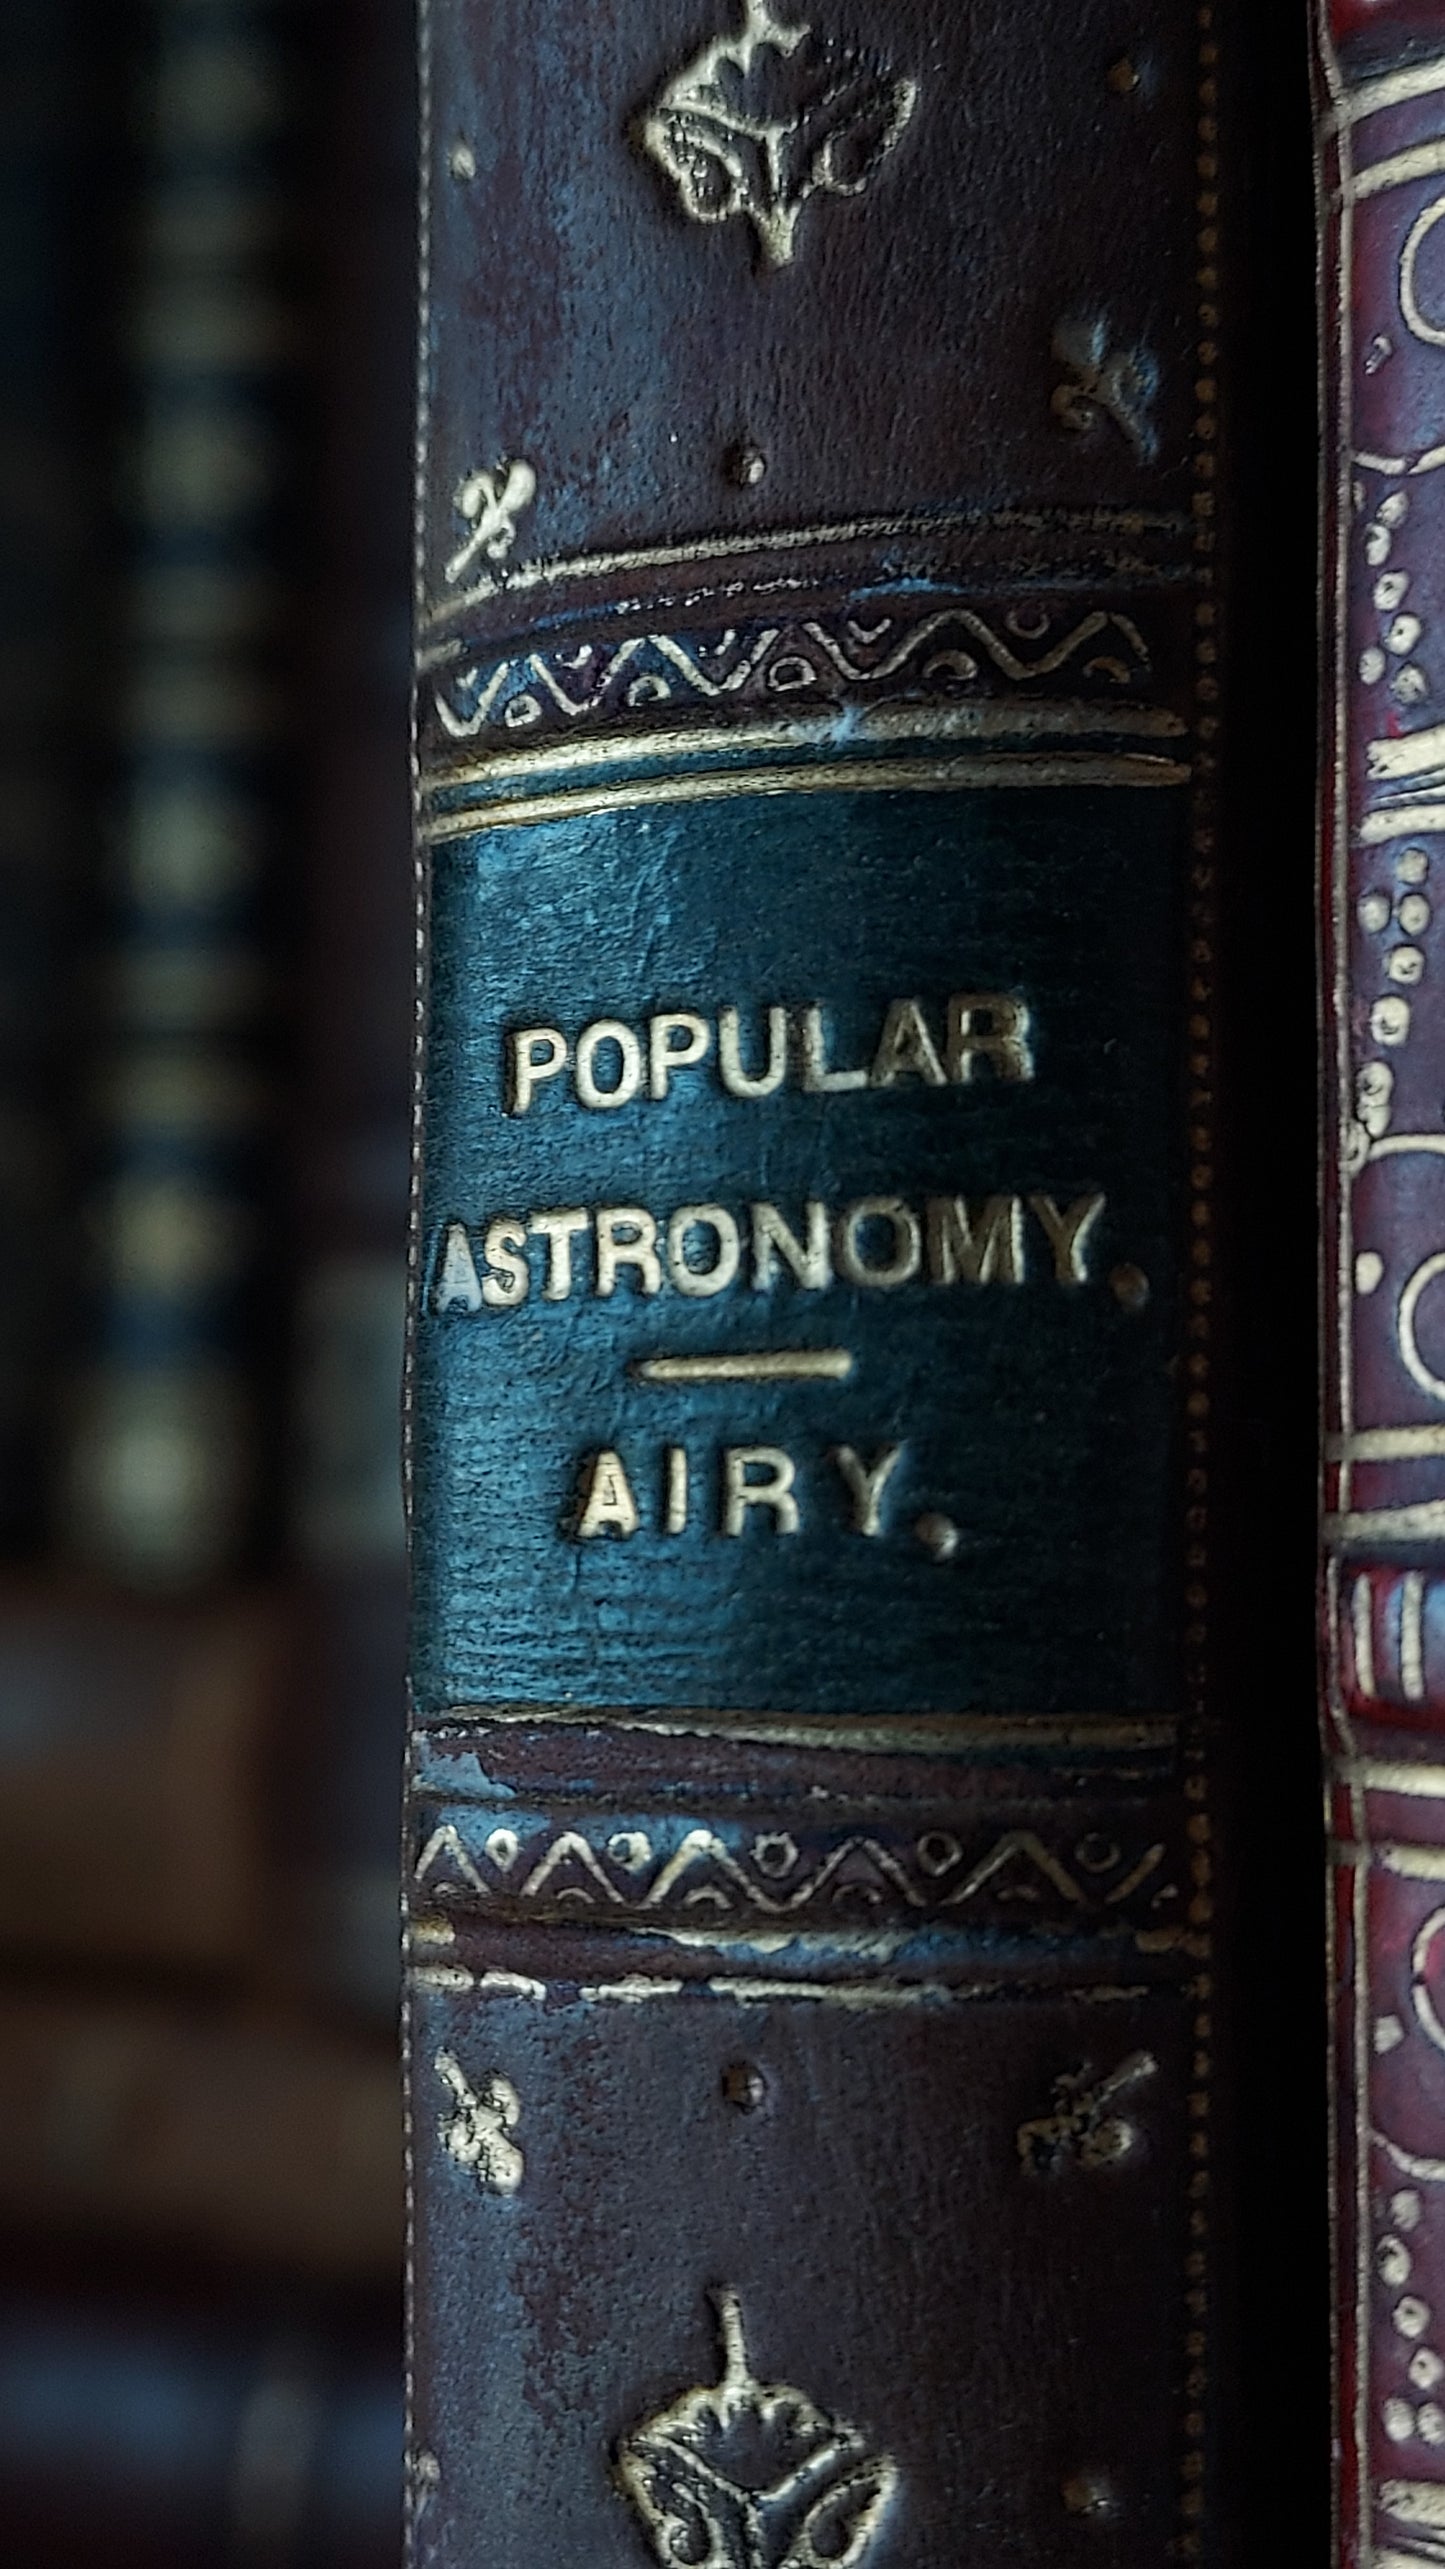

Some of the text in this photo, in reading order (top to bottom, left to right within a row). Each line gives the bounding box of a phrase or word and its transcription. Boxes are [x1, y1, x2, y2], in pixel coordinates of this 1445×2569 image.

[508, 993, 1036, 1115] POPULAR
[430, 1191, 1149, 1312] ASTRONOMY.
[575, 1443, 959, 1560] AIRY.
